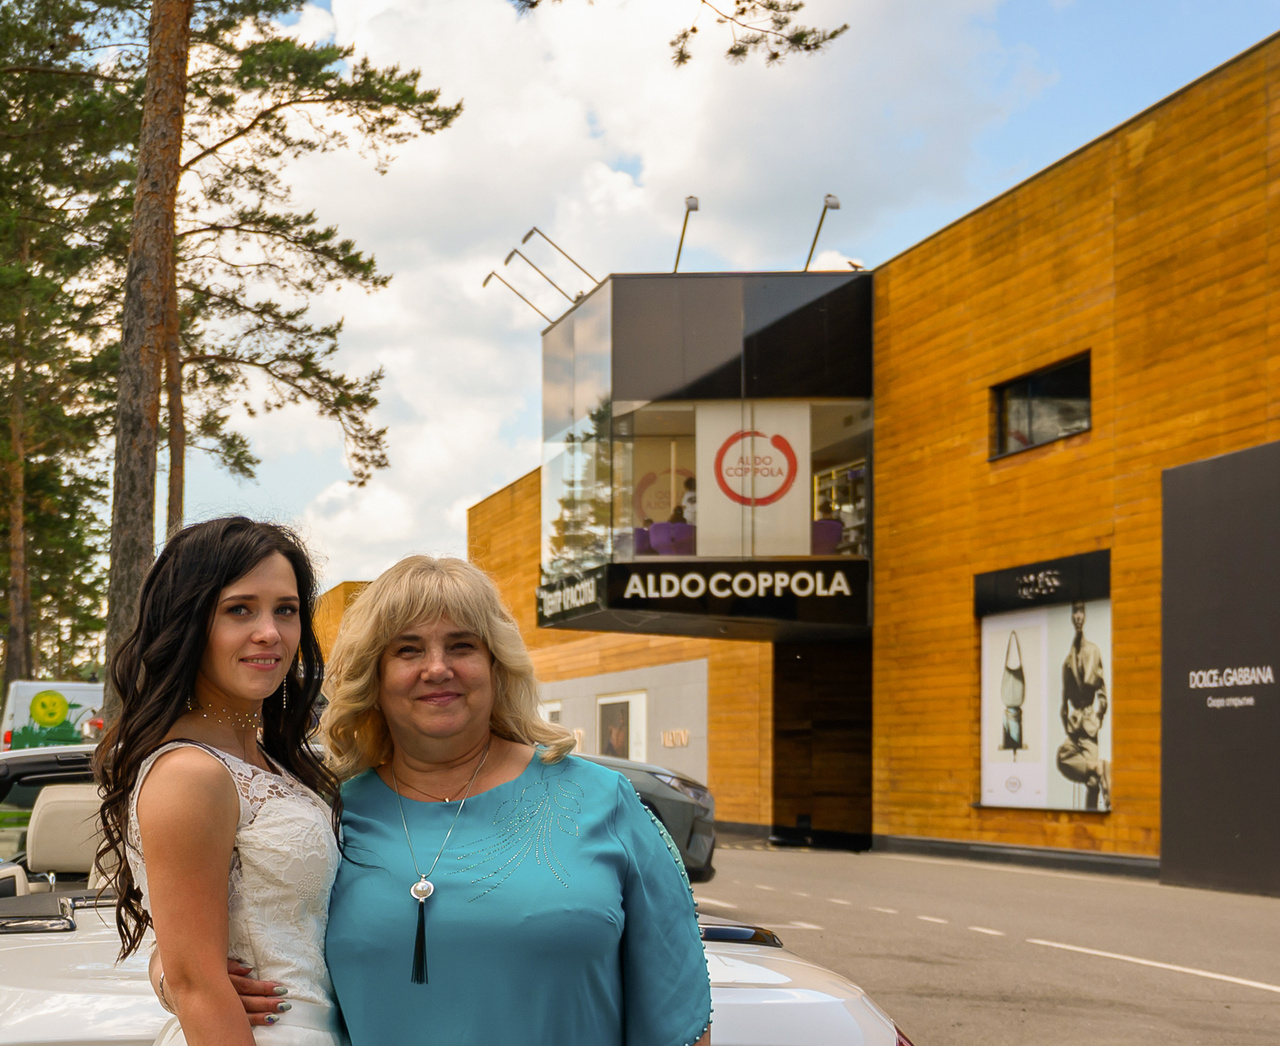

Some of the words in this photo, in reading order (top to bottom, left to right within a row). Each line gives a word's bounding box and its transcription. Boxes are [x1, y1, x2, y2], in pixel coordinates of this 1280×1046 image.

[737, 456, 773, 466] ALDO
[725, 467, 784, 477] COPPOLA
[623, 573, 706, 598] ALDO
[708, 571, 852, 597] COPPOLA
